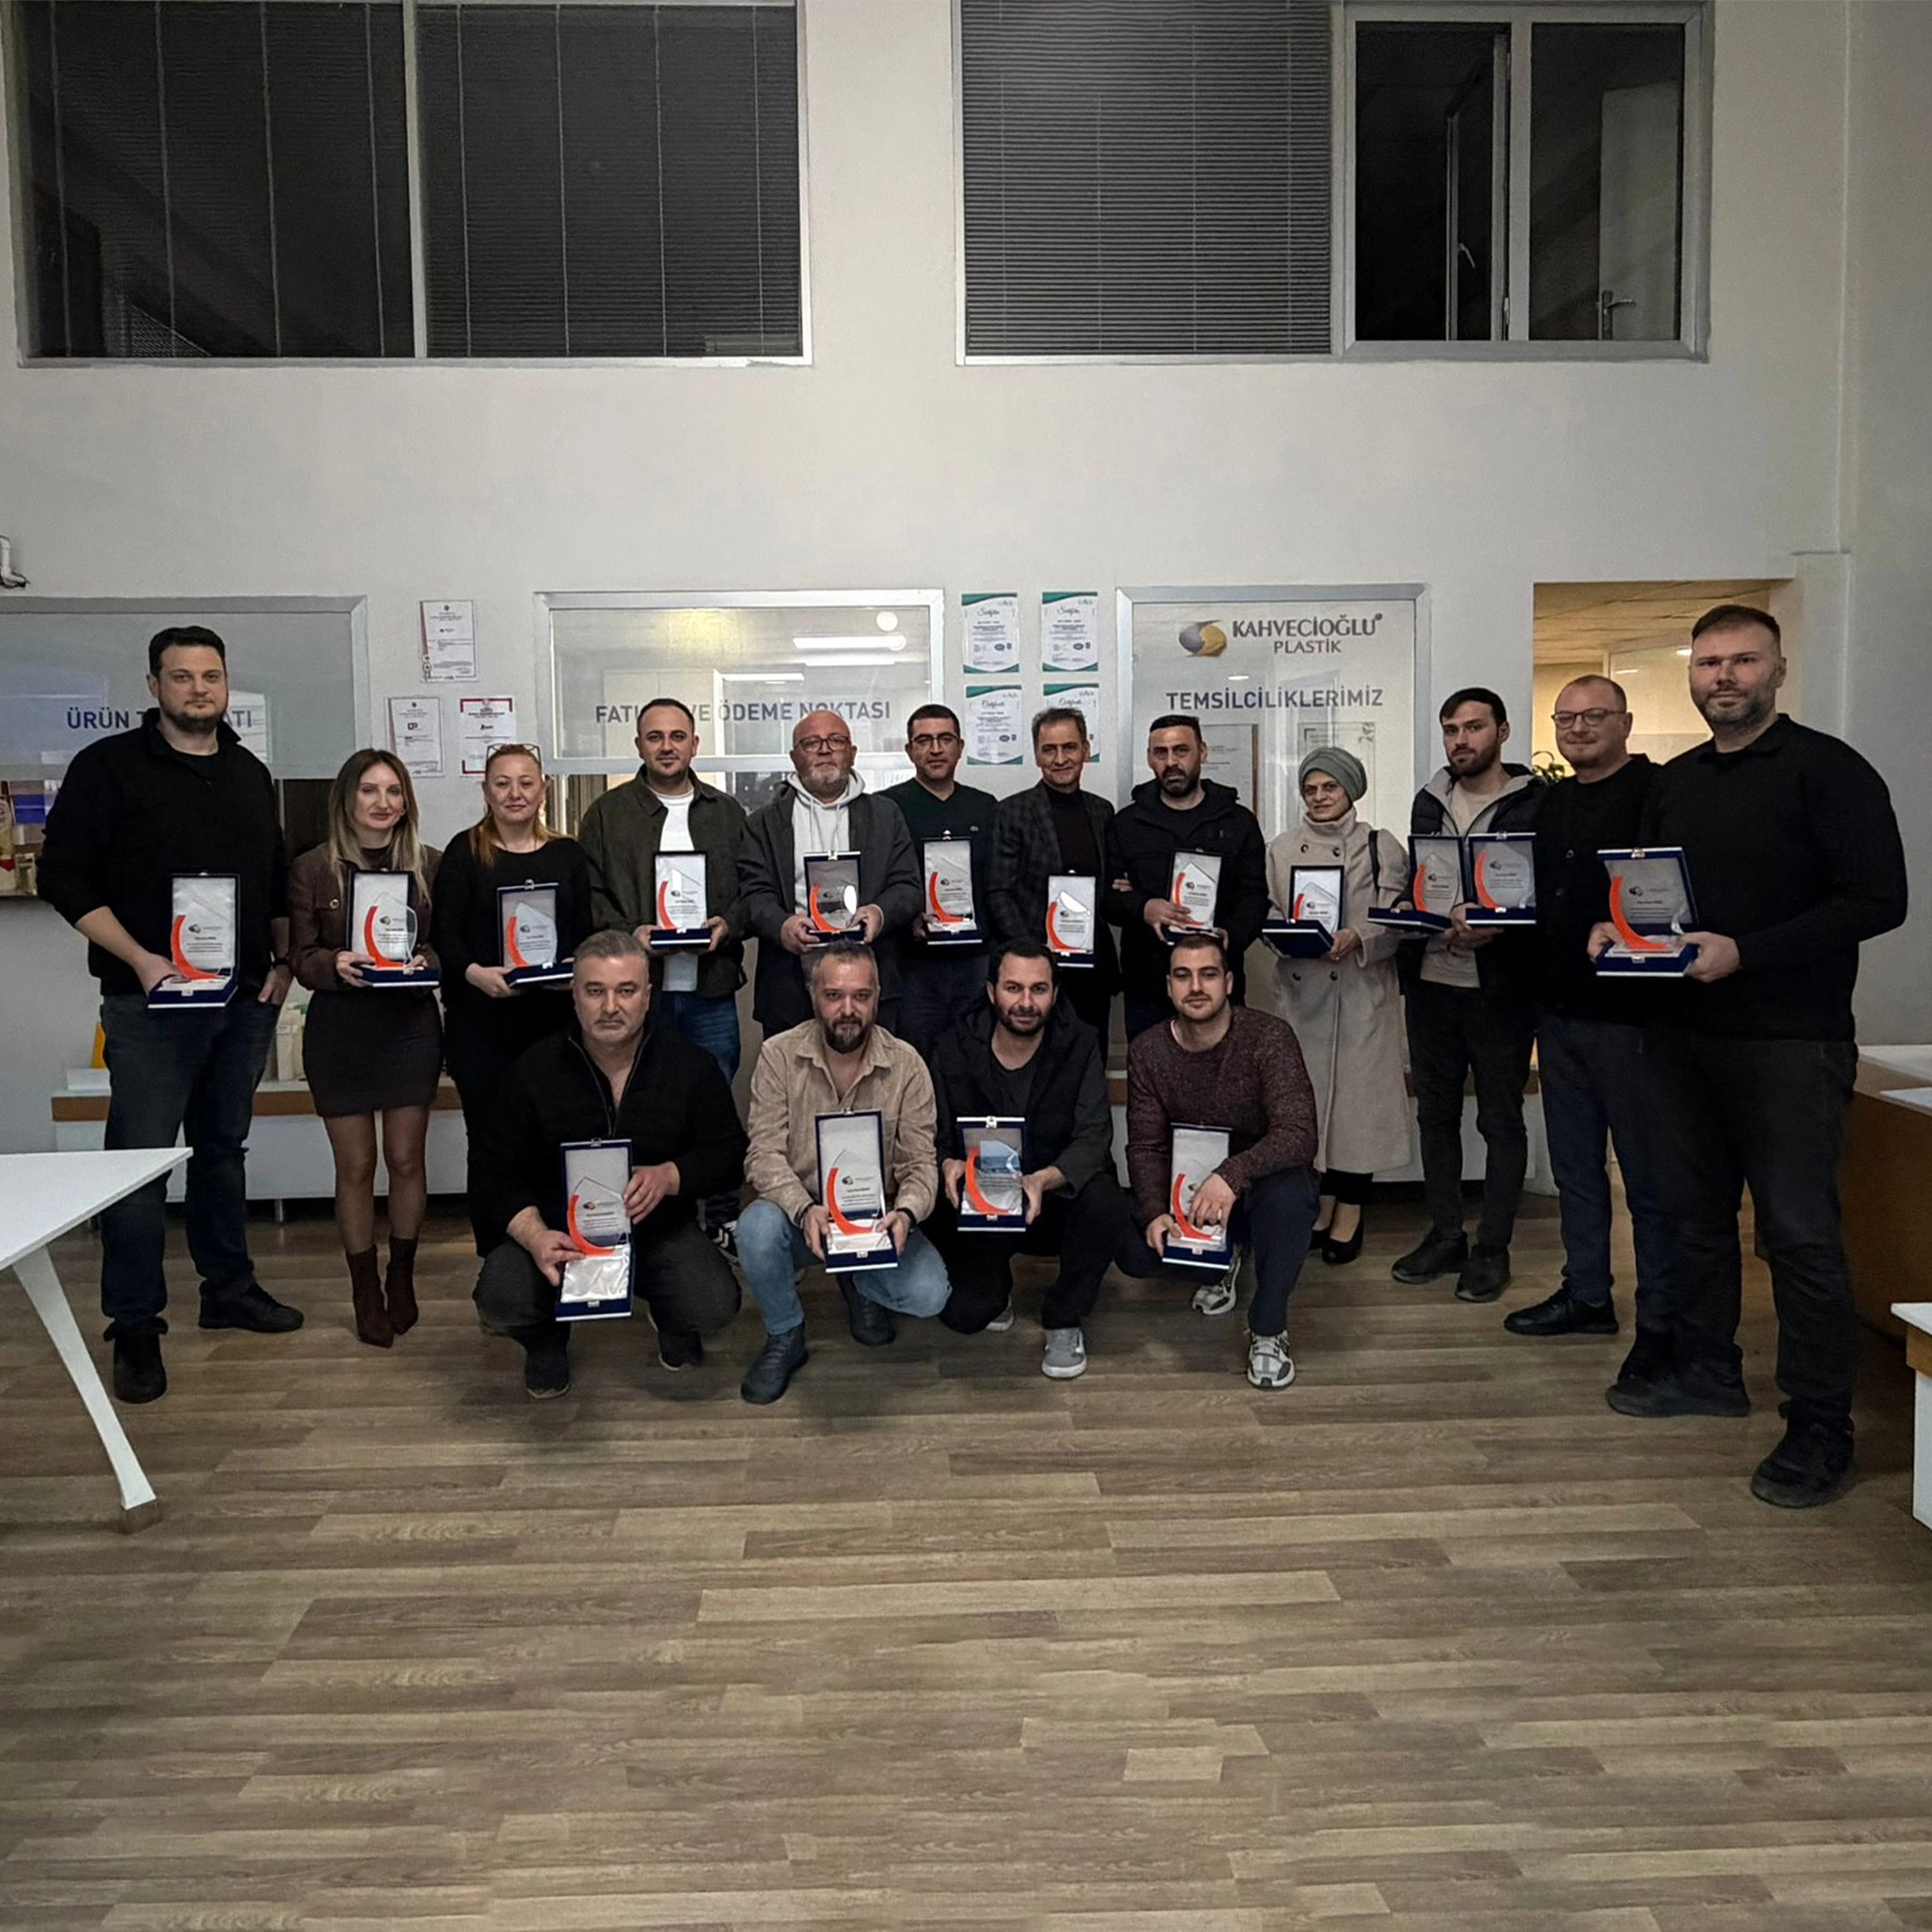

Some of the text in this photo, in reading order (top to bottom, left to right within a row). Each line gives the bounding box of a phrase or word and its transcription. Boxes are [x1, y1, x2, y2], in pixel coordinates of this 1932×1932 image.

[1233, 614, 1376, 638] KAHVECİOĞLU
[1274, 639, 1342, 654] PLASTİK
[1165, 684, 1384, 709] TEMSİLCİLİKLERİMİZ
[67, 707, 130, 728] ÜRÜN
[718, 699, 792, 721] ÖDEME
